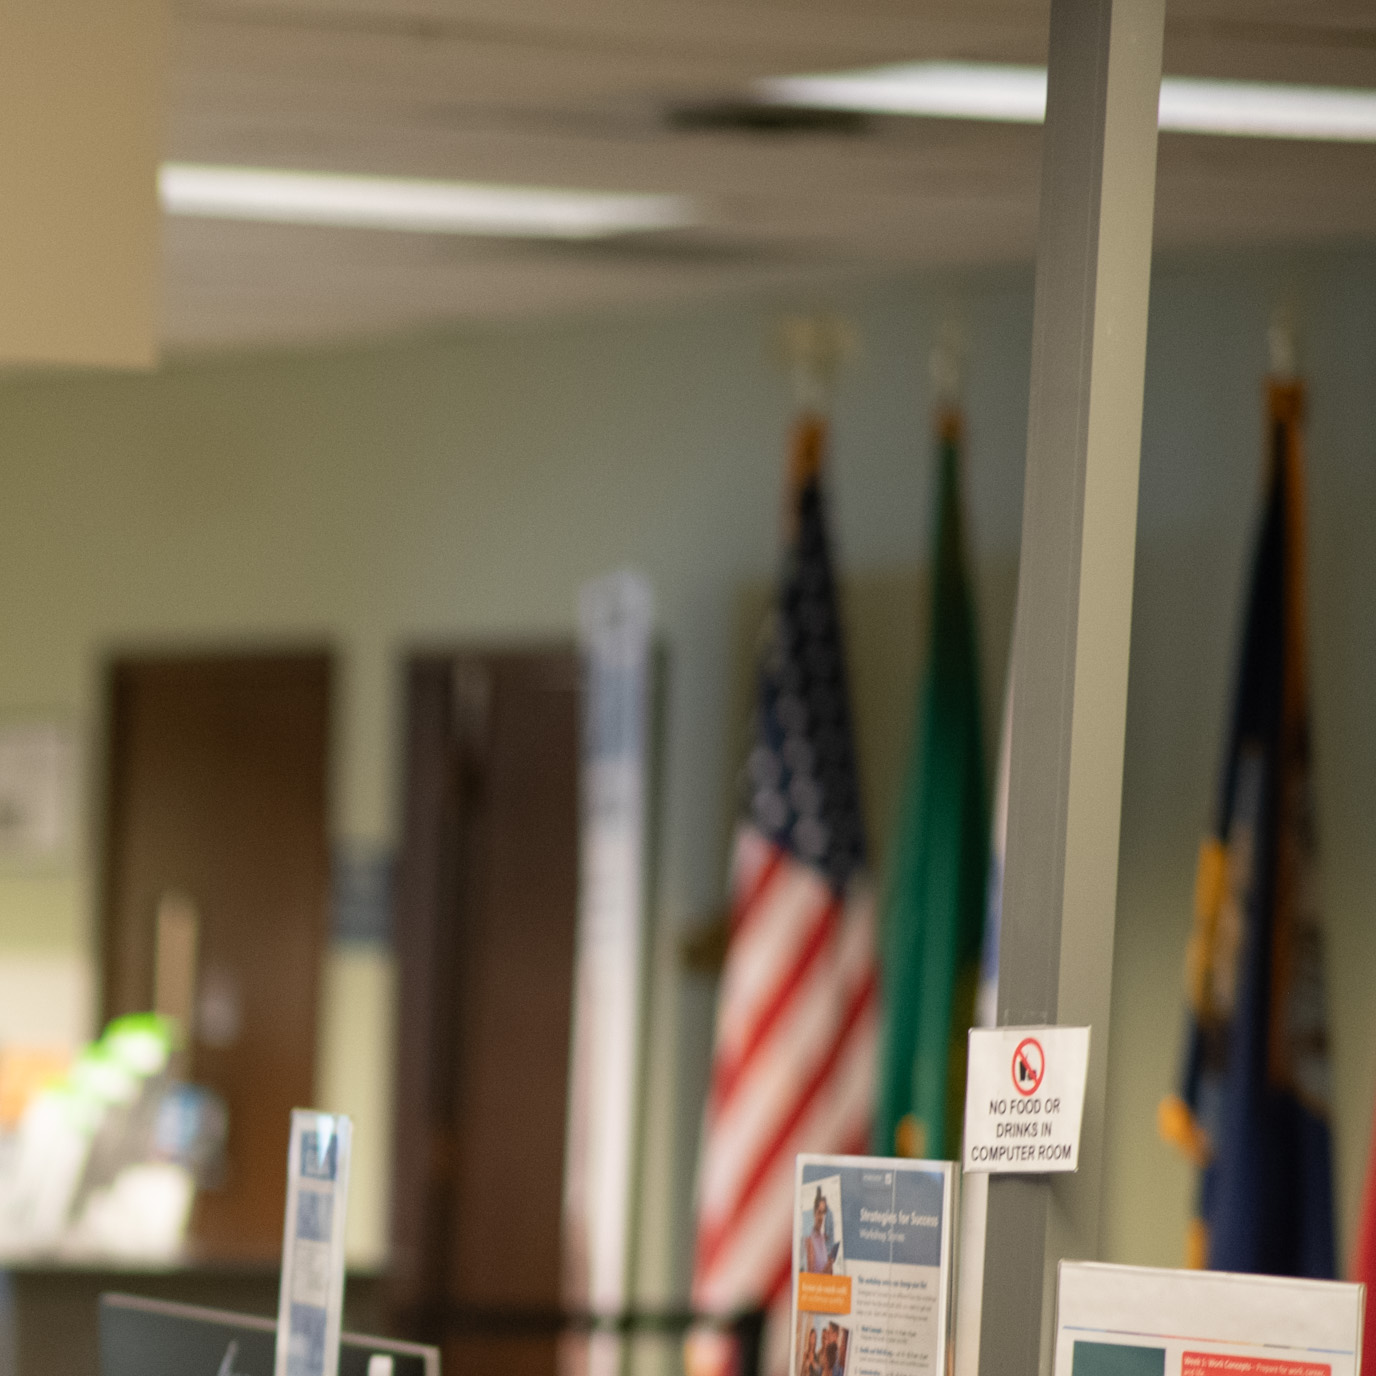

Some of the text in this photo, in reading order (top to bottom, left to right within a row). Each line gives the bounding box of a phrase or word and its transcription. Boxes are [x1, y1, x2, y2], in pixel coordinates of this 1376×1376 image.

[989, 1098, 1061, 1115] NO FOOD OR
[996, 1122, 1052, 1138] DRINKS IN
[971, 1144, 1072, 1161] COMPUTER ROOM
[860, 1207, 939, 1228] Strategies for Success
[1184, 1355, 1201, 1367] Week
[1208, 1358, 1224, 1369] Work
[1224, 1360, 1252, 1373] Concepts
